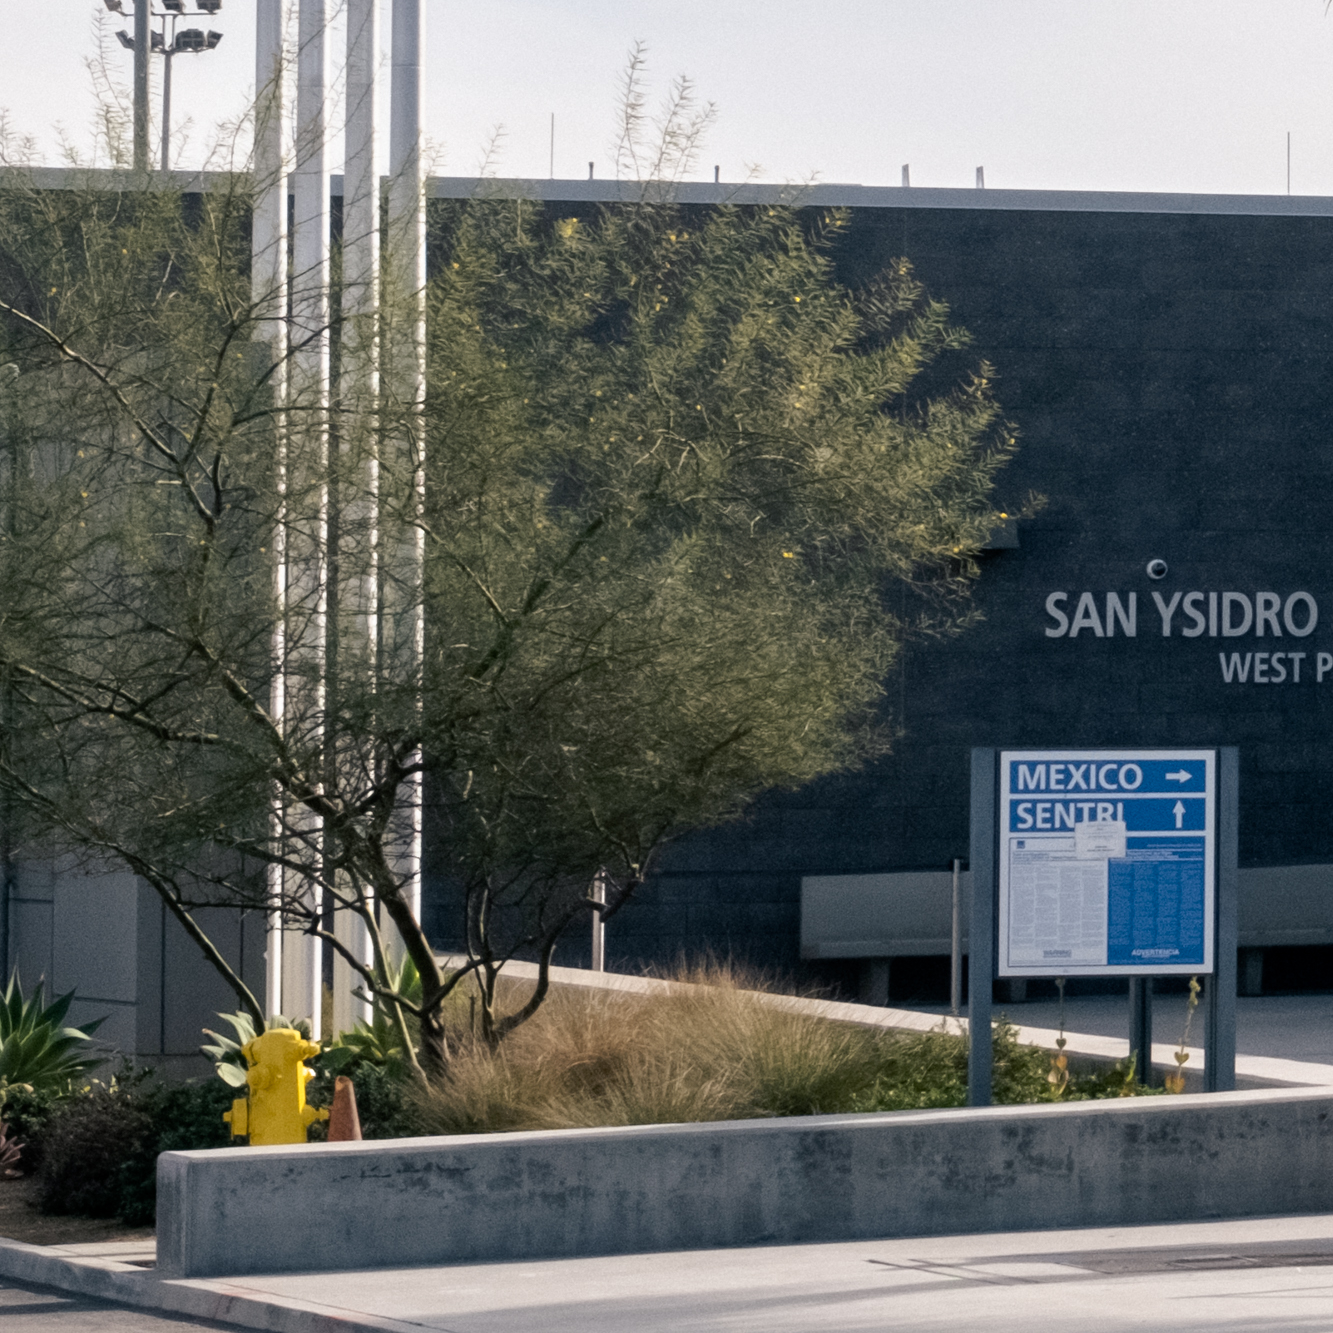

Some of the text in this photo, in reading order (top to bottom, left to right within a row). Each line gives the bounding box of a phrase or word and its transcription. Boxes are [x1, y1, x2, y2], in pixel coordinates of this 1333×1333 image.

[1044, 591, 1137, 638] SAN
[1151, 591, 1319, 638] YSIDRO
[1219, 652, 1306, 684] WEST
[1017, 763, 1143, 791] MEXICO
[1016, 801, 1124, 829] SENTRI
